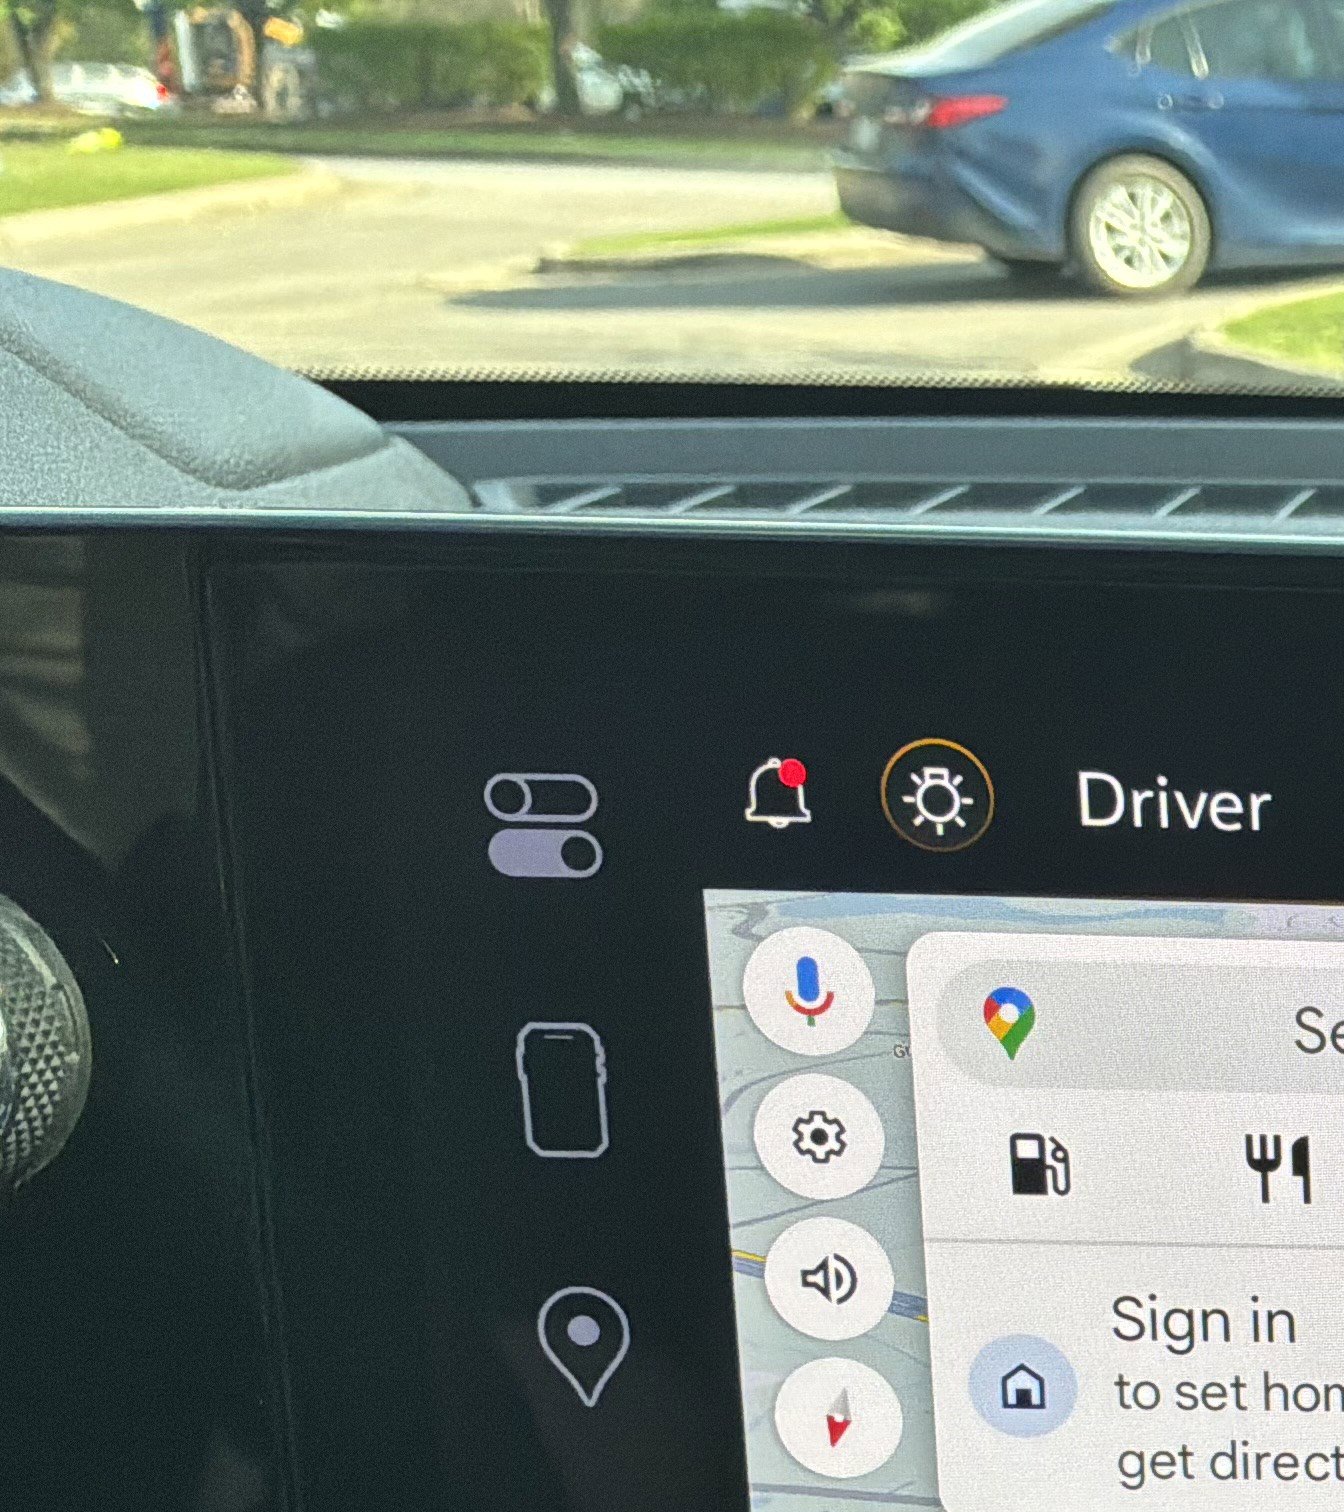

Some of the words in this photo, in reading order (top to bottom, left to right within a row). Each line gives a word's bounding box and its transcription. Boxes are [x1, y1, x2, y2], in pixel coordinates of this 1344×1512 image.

[1079, 770, 1272, 832] Driver
[1112, 1296, 1231, 1354] Sign
[1250, 1296, 1297, 1344] in
[1114, 1375, 1160, 1411] to
[1174, 1376, 1248, 1412] set
[1117, 1443, 1194, 1490] get
